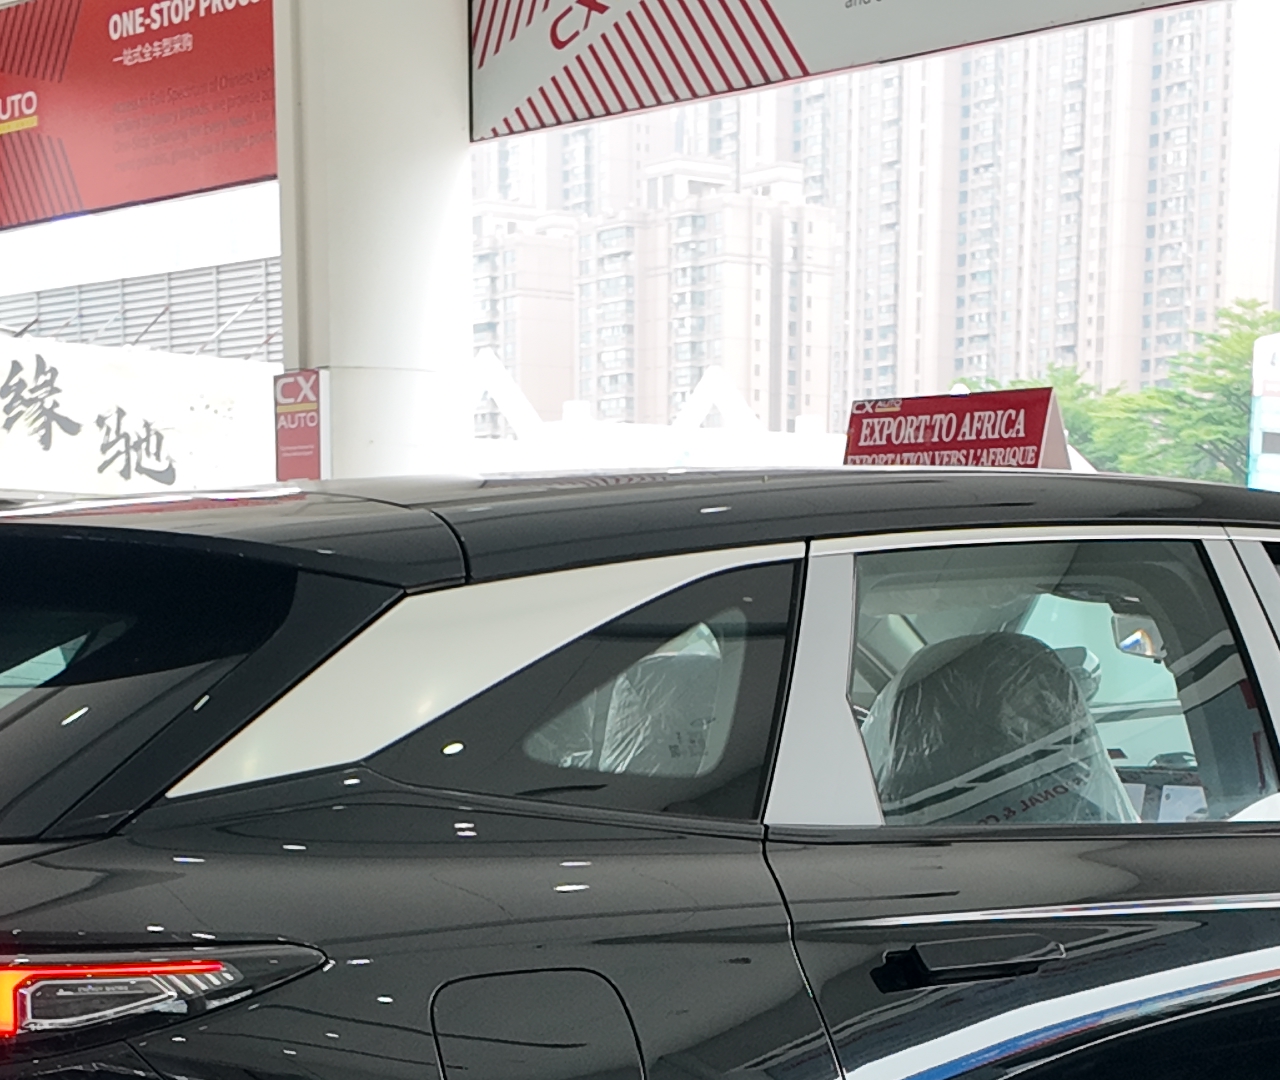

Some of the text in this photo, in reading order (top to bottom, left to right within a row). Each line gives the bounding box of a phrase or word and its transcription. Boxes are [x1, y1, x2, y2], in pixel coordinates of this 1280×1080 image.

[108, 0, 196, 40] ONE-STOP
[276, 374, 317, 404] CX
[852, 401, 874, 414] CX
[277, 411, 318, 429] AUTO
[858, 408, 1025, 447] EXPORT TO AFRICA
[934, 449, 967, 465] VERS
[970, 446, 1037, 465] L'AFRIQUE
